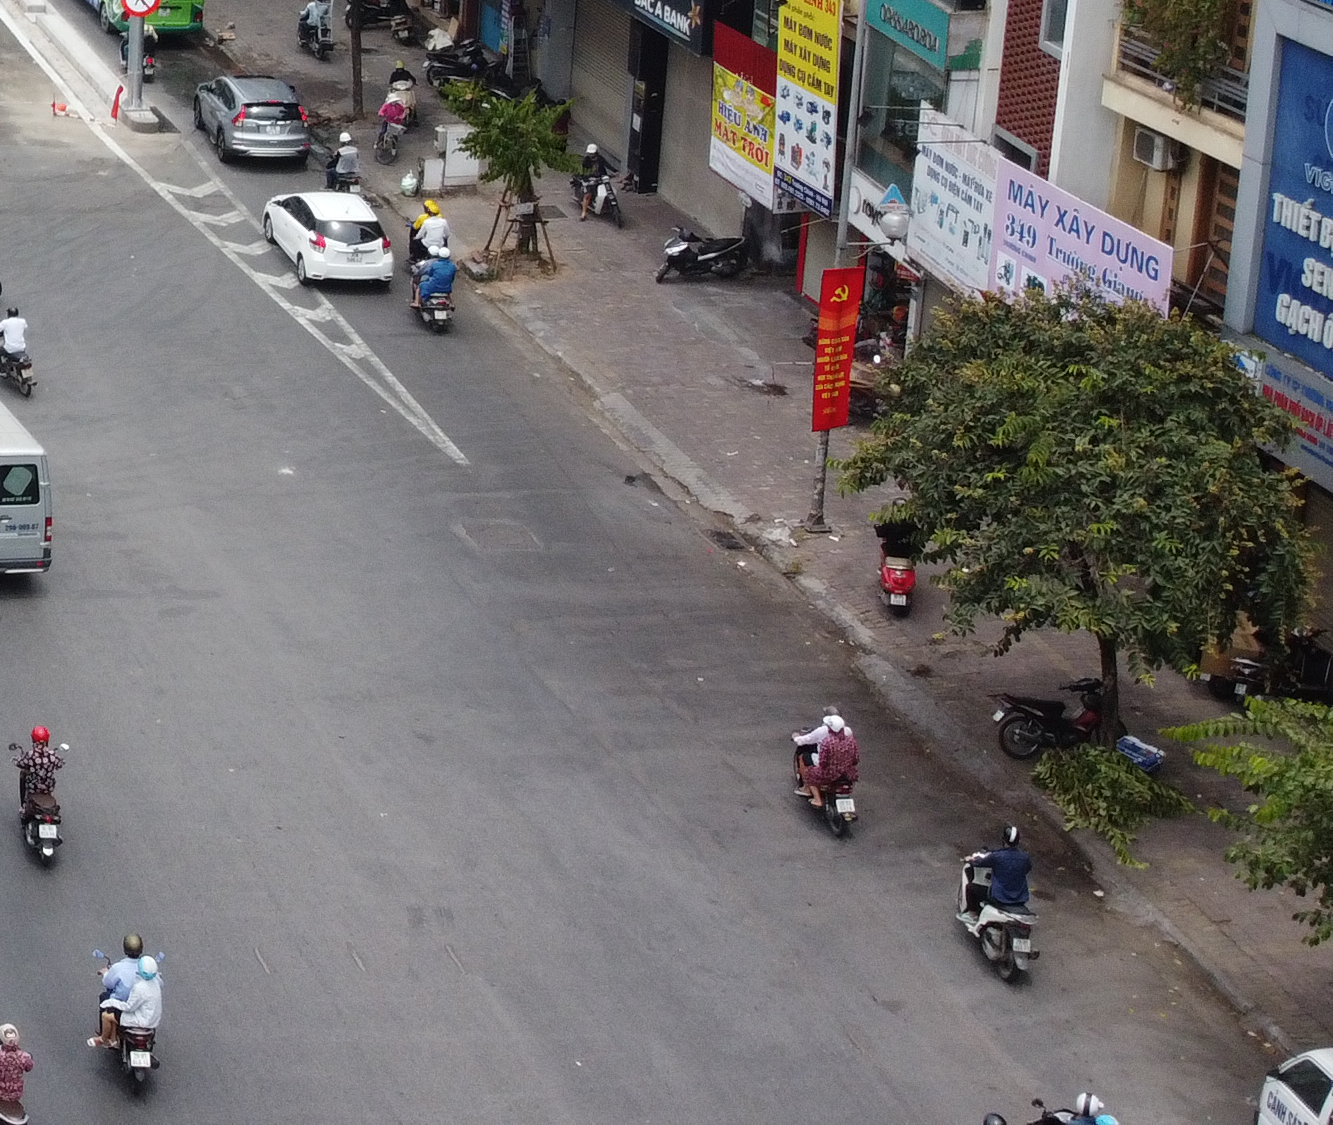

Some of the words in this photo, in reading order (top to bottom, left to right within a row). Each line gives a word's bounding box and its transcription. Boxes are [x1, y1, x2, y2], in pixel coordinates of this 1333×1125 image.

[654, 1, 663, 18] A
[663, 5, 691, 35] BANK
[783, 15, 796, 33] MÁY
[783, 37, 796, 54] MÁY
[718, 100, 742, 127] HIỆU
[1005, 212, 1037, 250] 349
[1007, 178, 1050, 220] MÁY
[1054, 207, 1096, 246] XÂY
[1101, 230, 1160, 281] DỰNG
